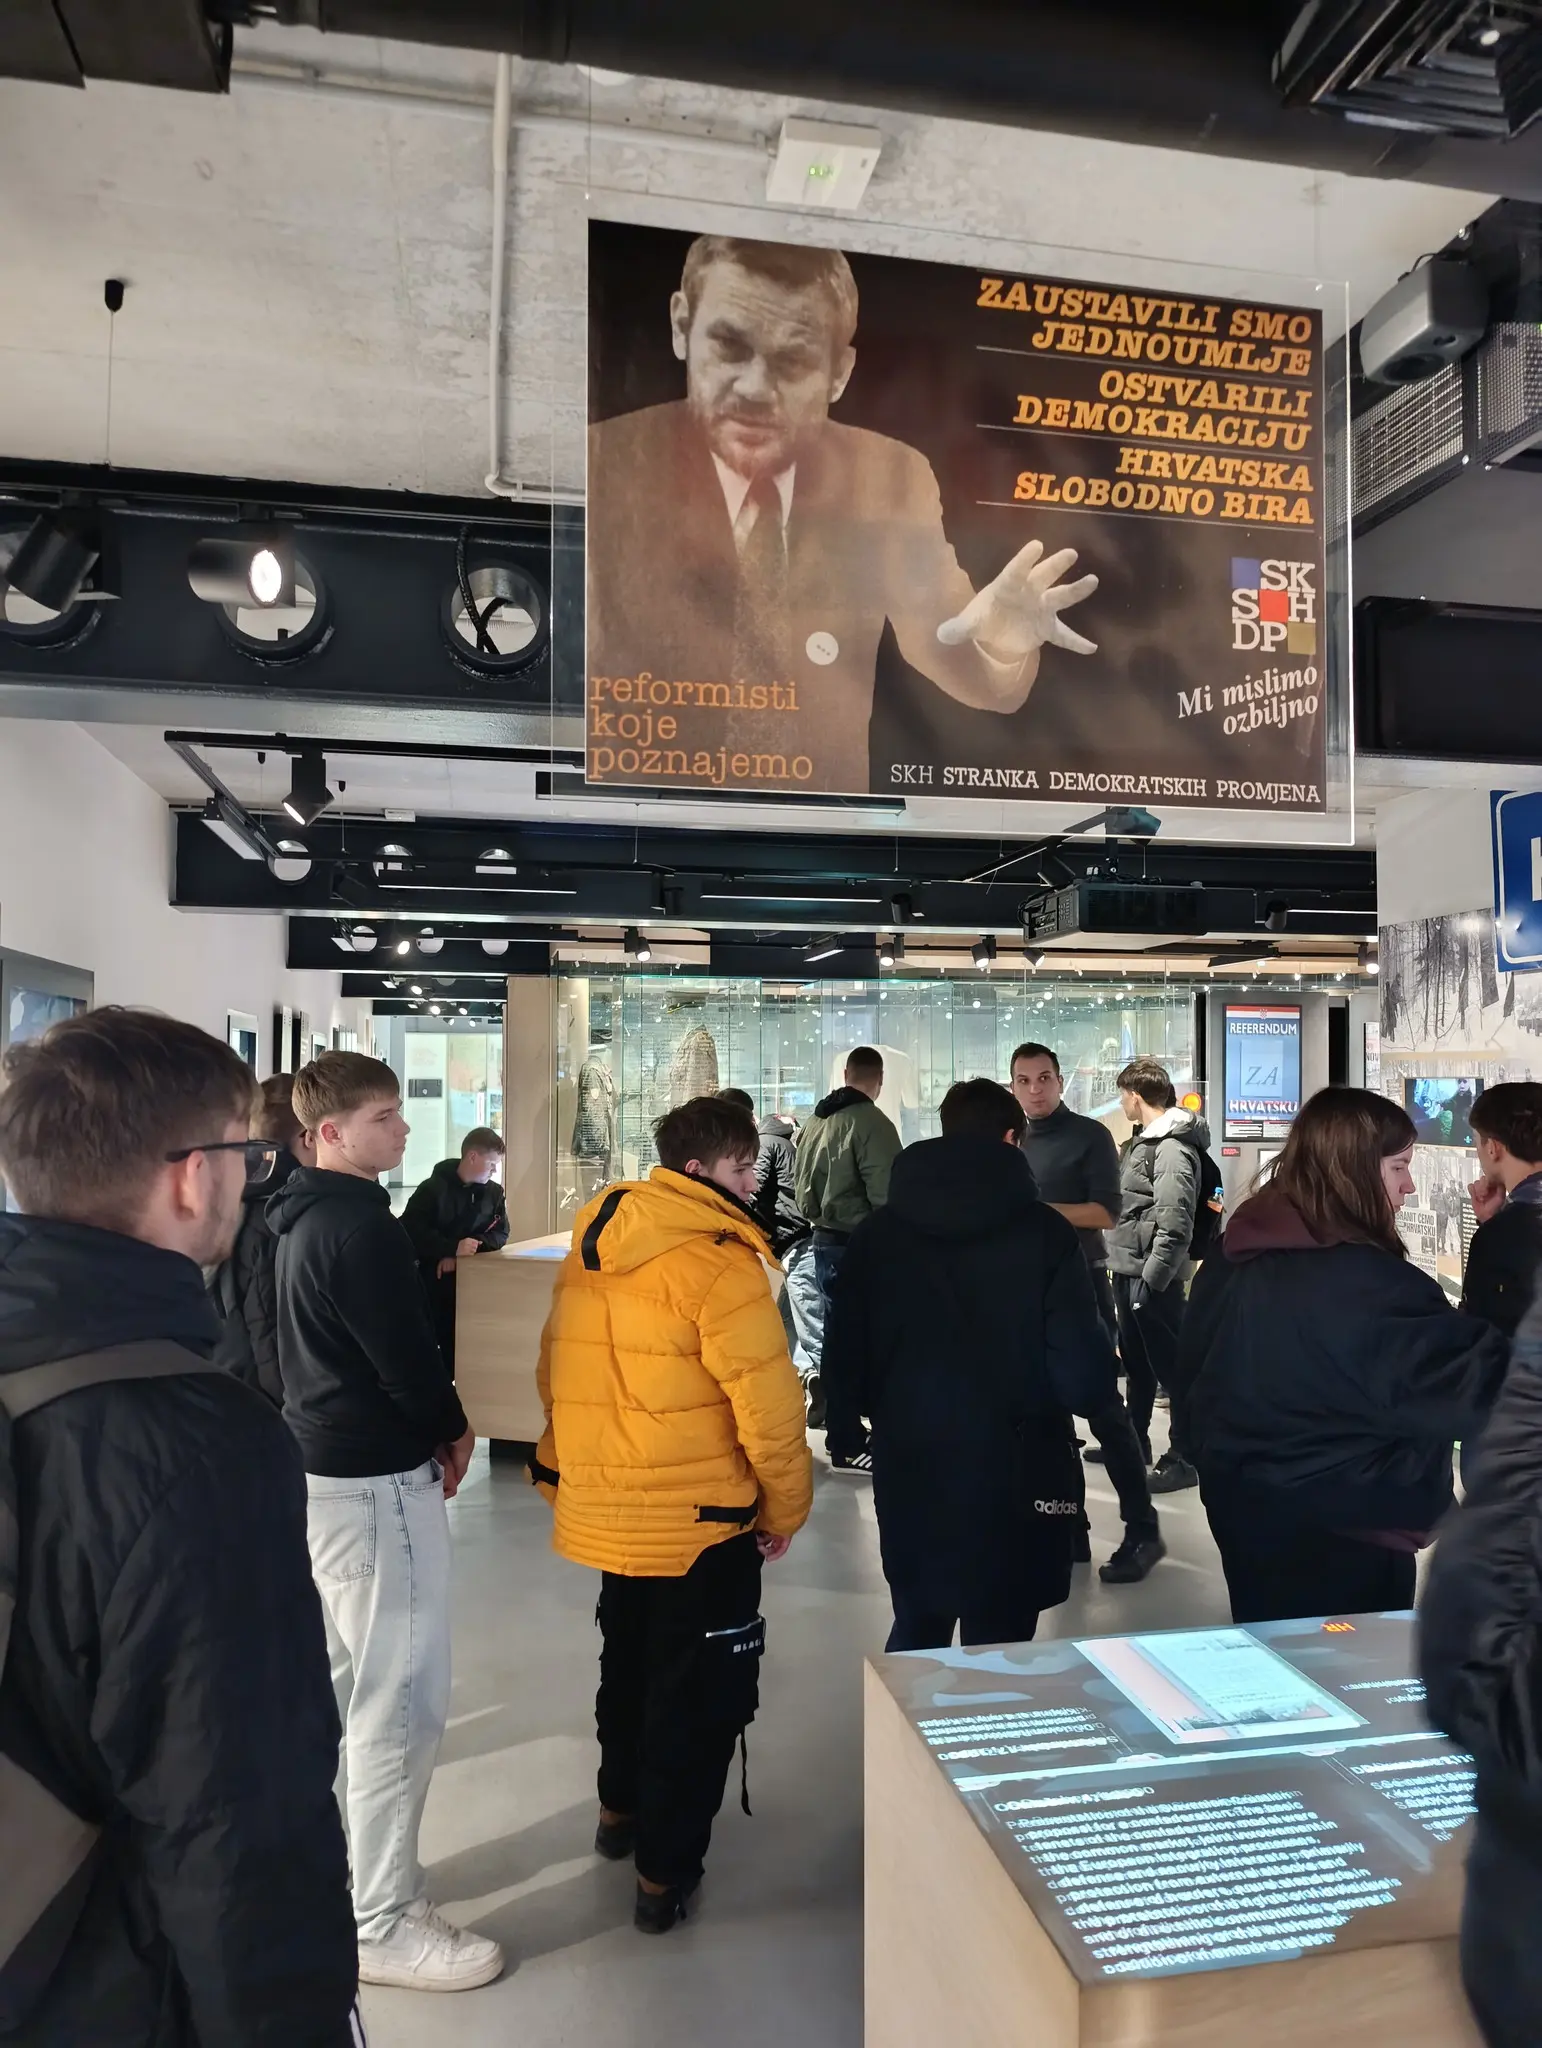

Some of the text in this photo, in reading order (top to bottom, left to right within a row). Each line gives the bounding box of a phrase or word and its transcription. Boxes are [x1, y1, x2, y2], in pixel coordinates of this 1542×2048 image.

[976, 277, 1312, 343] ZAUSTAVILI SMO
[1032, 321, 1312, 376] JEDNOUMLJE
[1100, 370, 1312, 418] OSTVARILI
[1013, 395, 1312, 450] DEMOKRACIJU
[1115, 447, 1313, 491] HRVATSKA
[1014, 471, 1314, 524] SLOBODNO BIRA
[1260, 559, 1316, 593] SK
[1232, 618, 1288, 652] DP
[590, 672, 799, 710] reformisti
[1177, 666, 1317, 718] Mi mislimo
[590, 705, 677, 747] koje
[1223, 695, 1318, 735] ozbiljno
[588, 746, 813, 784] poznajemo
[890, 764, 1321, 803] SKH STRANKA DEMOKRATSKIH PROMJENA
[1229, 1022, 1297, 1035] REFERENDUM
[1245, 1066, 1279, 1086] ZA
[1229, 1100, 1298, 1114] HRVATSKU
[1034, 1499, 1078, 1515] adidas
